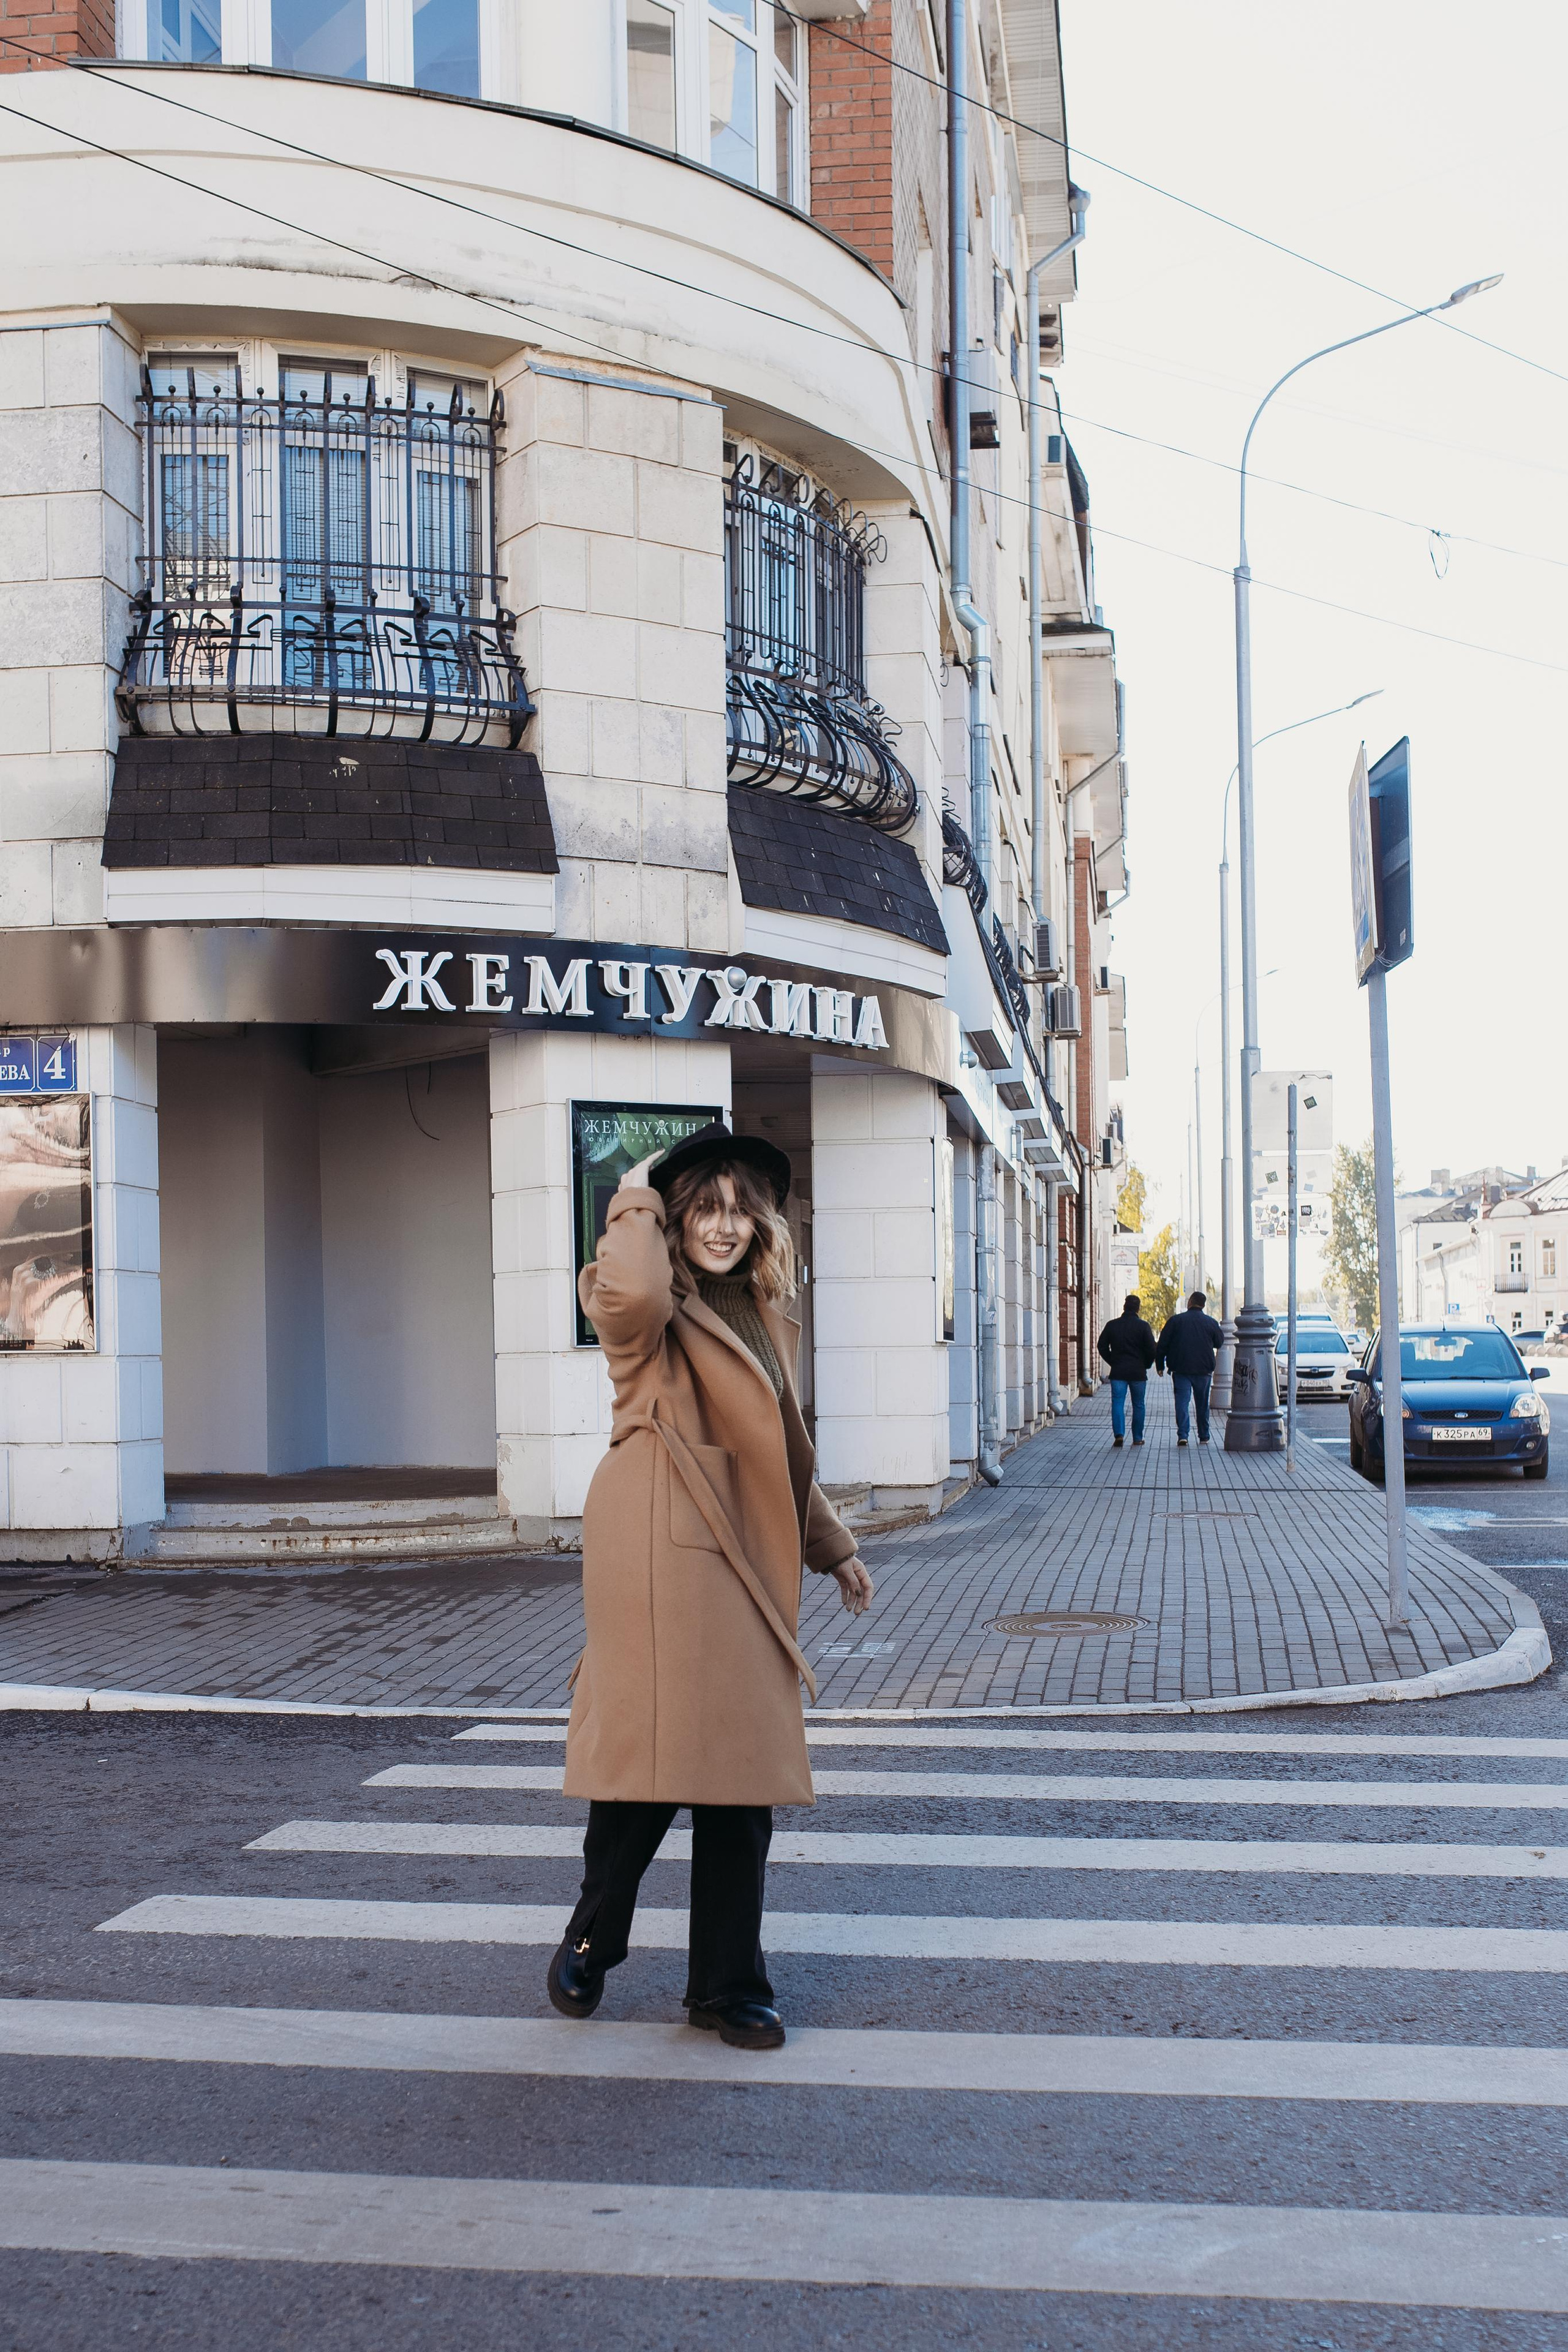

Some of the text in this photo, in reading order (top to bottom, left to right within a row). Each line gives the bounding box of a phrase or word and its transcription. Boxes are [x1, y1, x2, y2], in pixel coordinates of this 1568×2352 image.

[372, 948, 891, 1051] ЖЕМЧУЖИНА
[0, 1047, 10, 1057] р
[43, 1046, 66, 1080] 4
[584, 1119, 706, 1136] ЖЕМЧУЖИН
